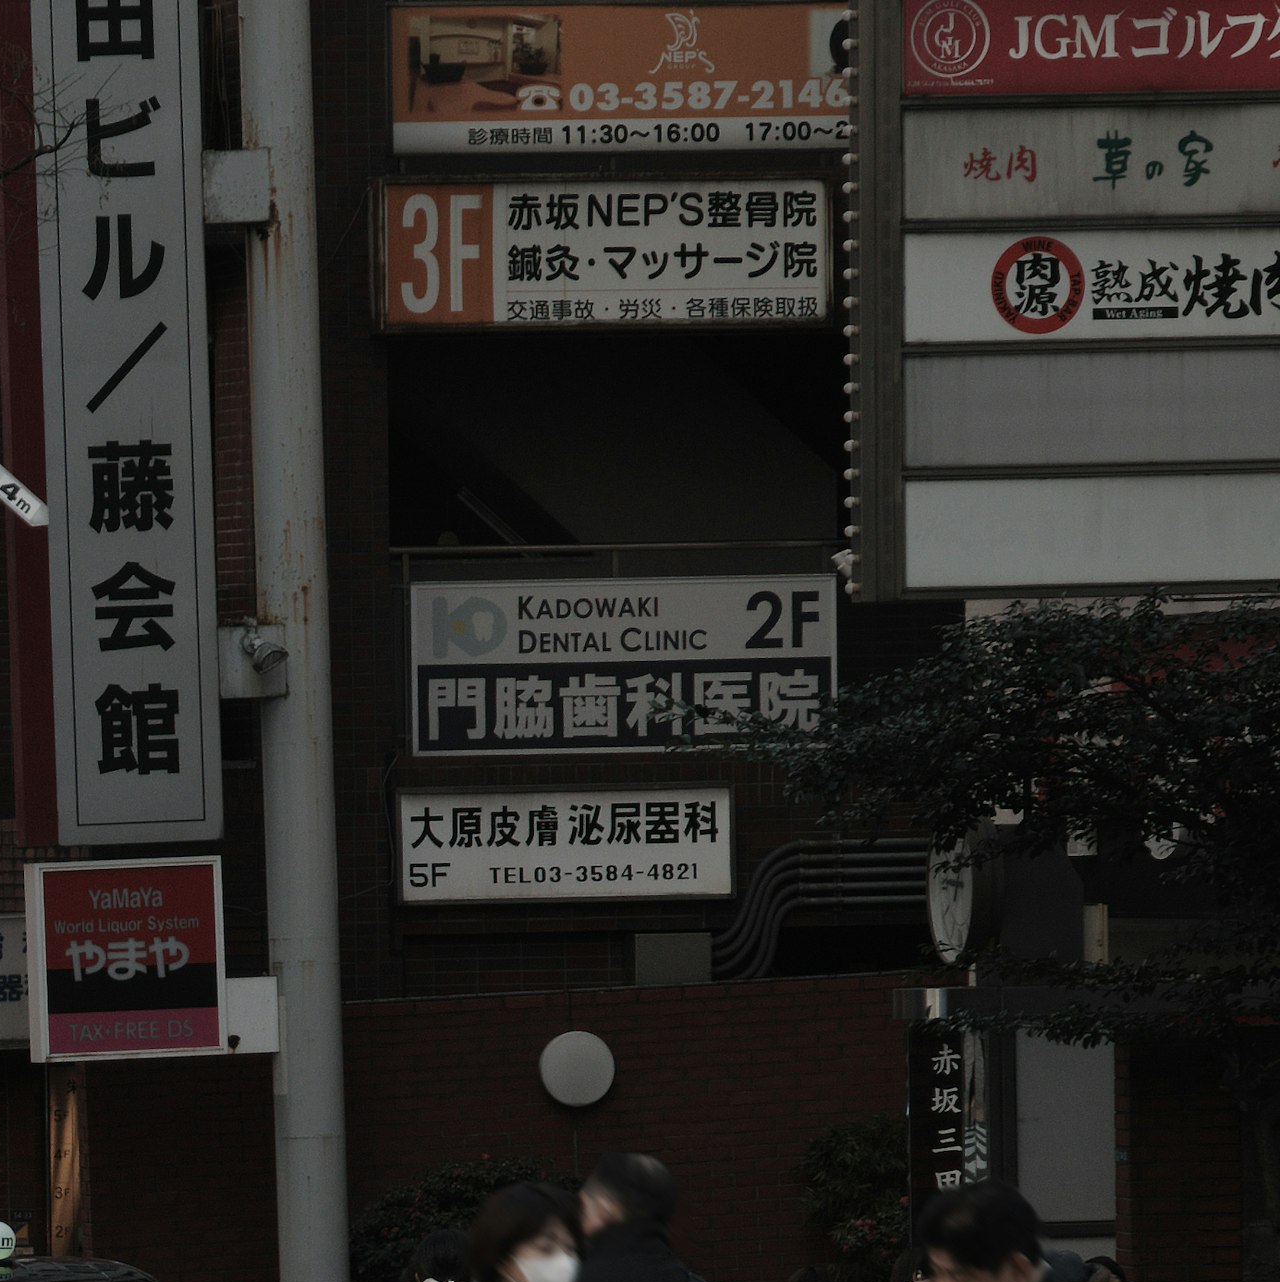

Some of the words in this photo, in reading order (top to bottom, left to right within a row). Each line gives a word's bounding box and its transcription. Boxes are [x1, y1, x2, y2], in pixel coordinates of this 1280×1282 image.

[569, 79, 849, 112] 03-3587-2146
[468, 127, 553, 145] 診療時間
[963, 145, 1037, 182] 焼肉
[1092, 130, 1214, 190] 草の家
[401, 193, 482, 314] 3F
[1022, 239, 1054, 252] WINE
[508, 241, 818, 282] 鍼灸・マッサージ院
[1014, 253, 1061, 316] 肉源
[1105, 308, 1127, 319] Wet
[1130, 308, 1164, 319] Aging
[518, 595, 659, 620] KADOWAKI
[745, 590, 820, 649] 2F
[518, 630, 612, 655] DENTAL
[621, 627, 708, 652] CLINIC
[427, 668, 823, 741] 門脇歯科医院
[409, 862, 451, 888] 5F
[88, 887, 164, 910] YaMaYa
[54, 918, 94, 935] World
[98, 916, 143, 935] Liquor
[147, 915, 200, 934] System
[65, 936, 190, 982] やまや
[167, 1020, 193, 1038] DS
[55, 1186, 71, 1200] 3F
